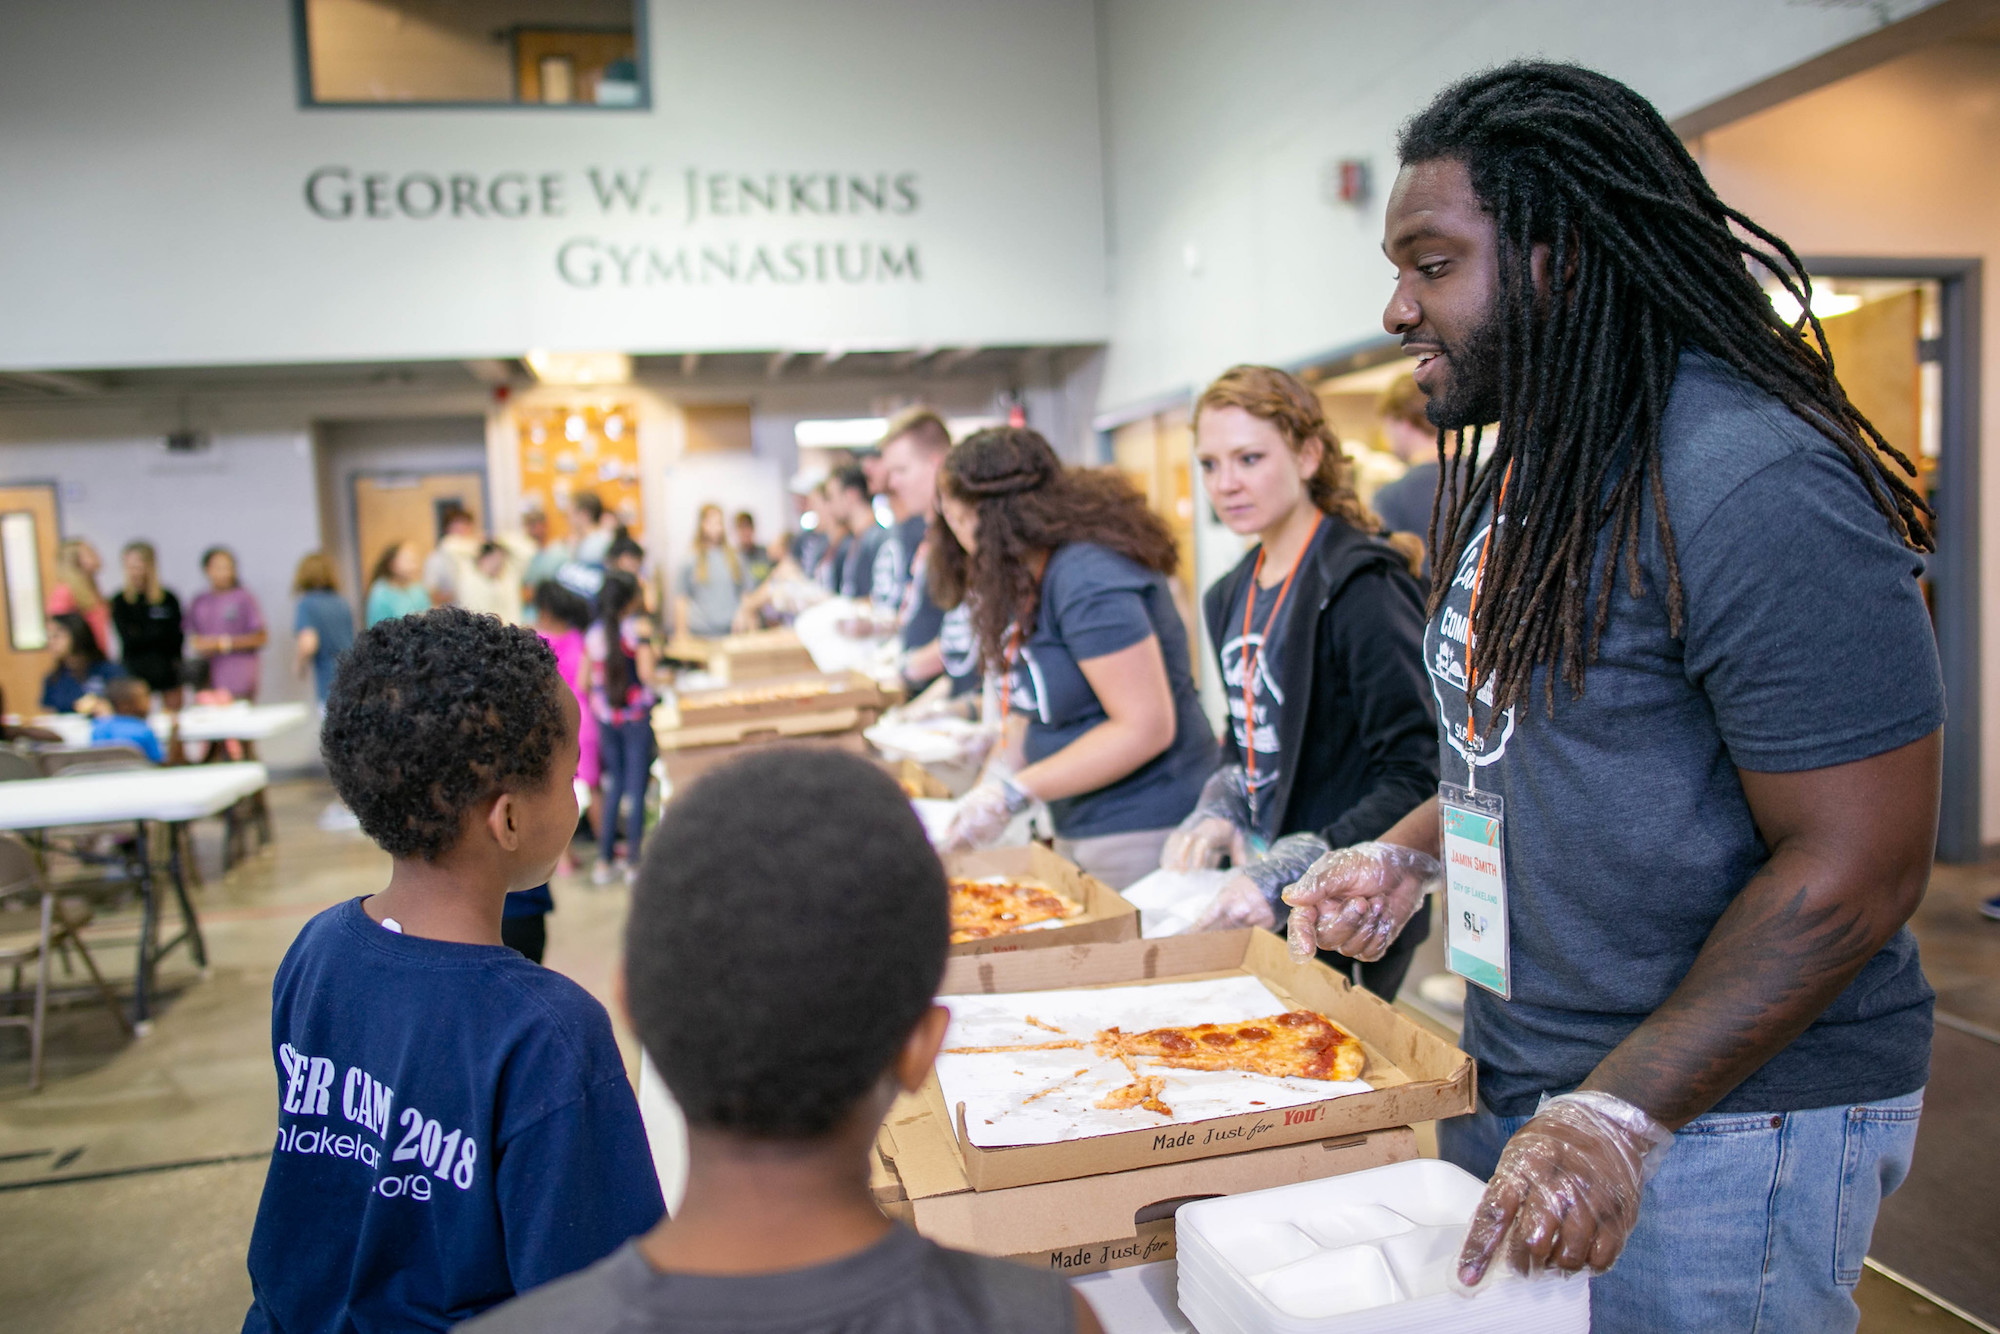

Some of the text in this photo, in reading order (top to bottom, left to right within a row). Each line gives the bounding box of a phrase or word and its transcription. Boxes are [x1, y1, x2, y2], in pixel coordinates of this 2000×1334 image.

[305, 165, 921, 224] GEORGE W. JENKINS
[557, 237, 922, 288] GYMNASIUM
[1451, 850, 1497, 877] JAMIN SMITH
[1464, 911, 1488, 936] SLP
[342, 1066, 394, 1140] CAM
[392, 1107, 477, 1190] 2018
[1152, 1131, 1195, 1151] Made
[1203, 1126, 1247, 1146] Just
[1245, 1118, 1275, 1141] for
[1050, 1235, 1169, 1270] Made Just for
